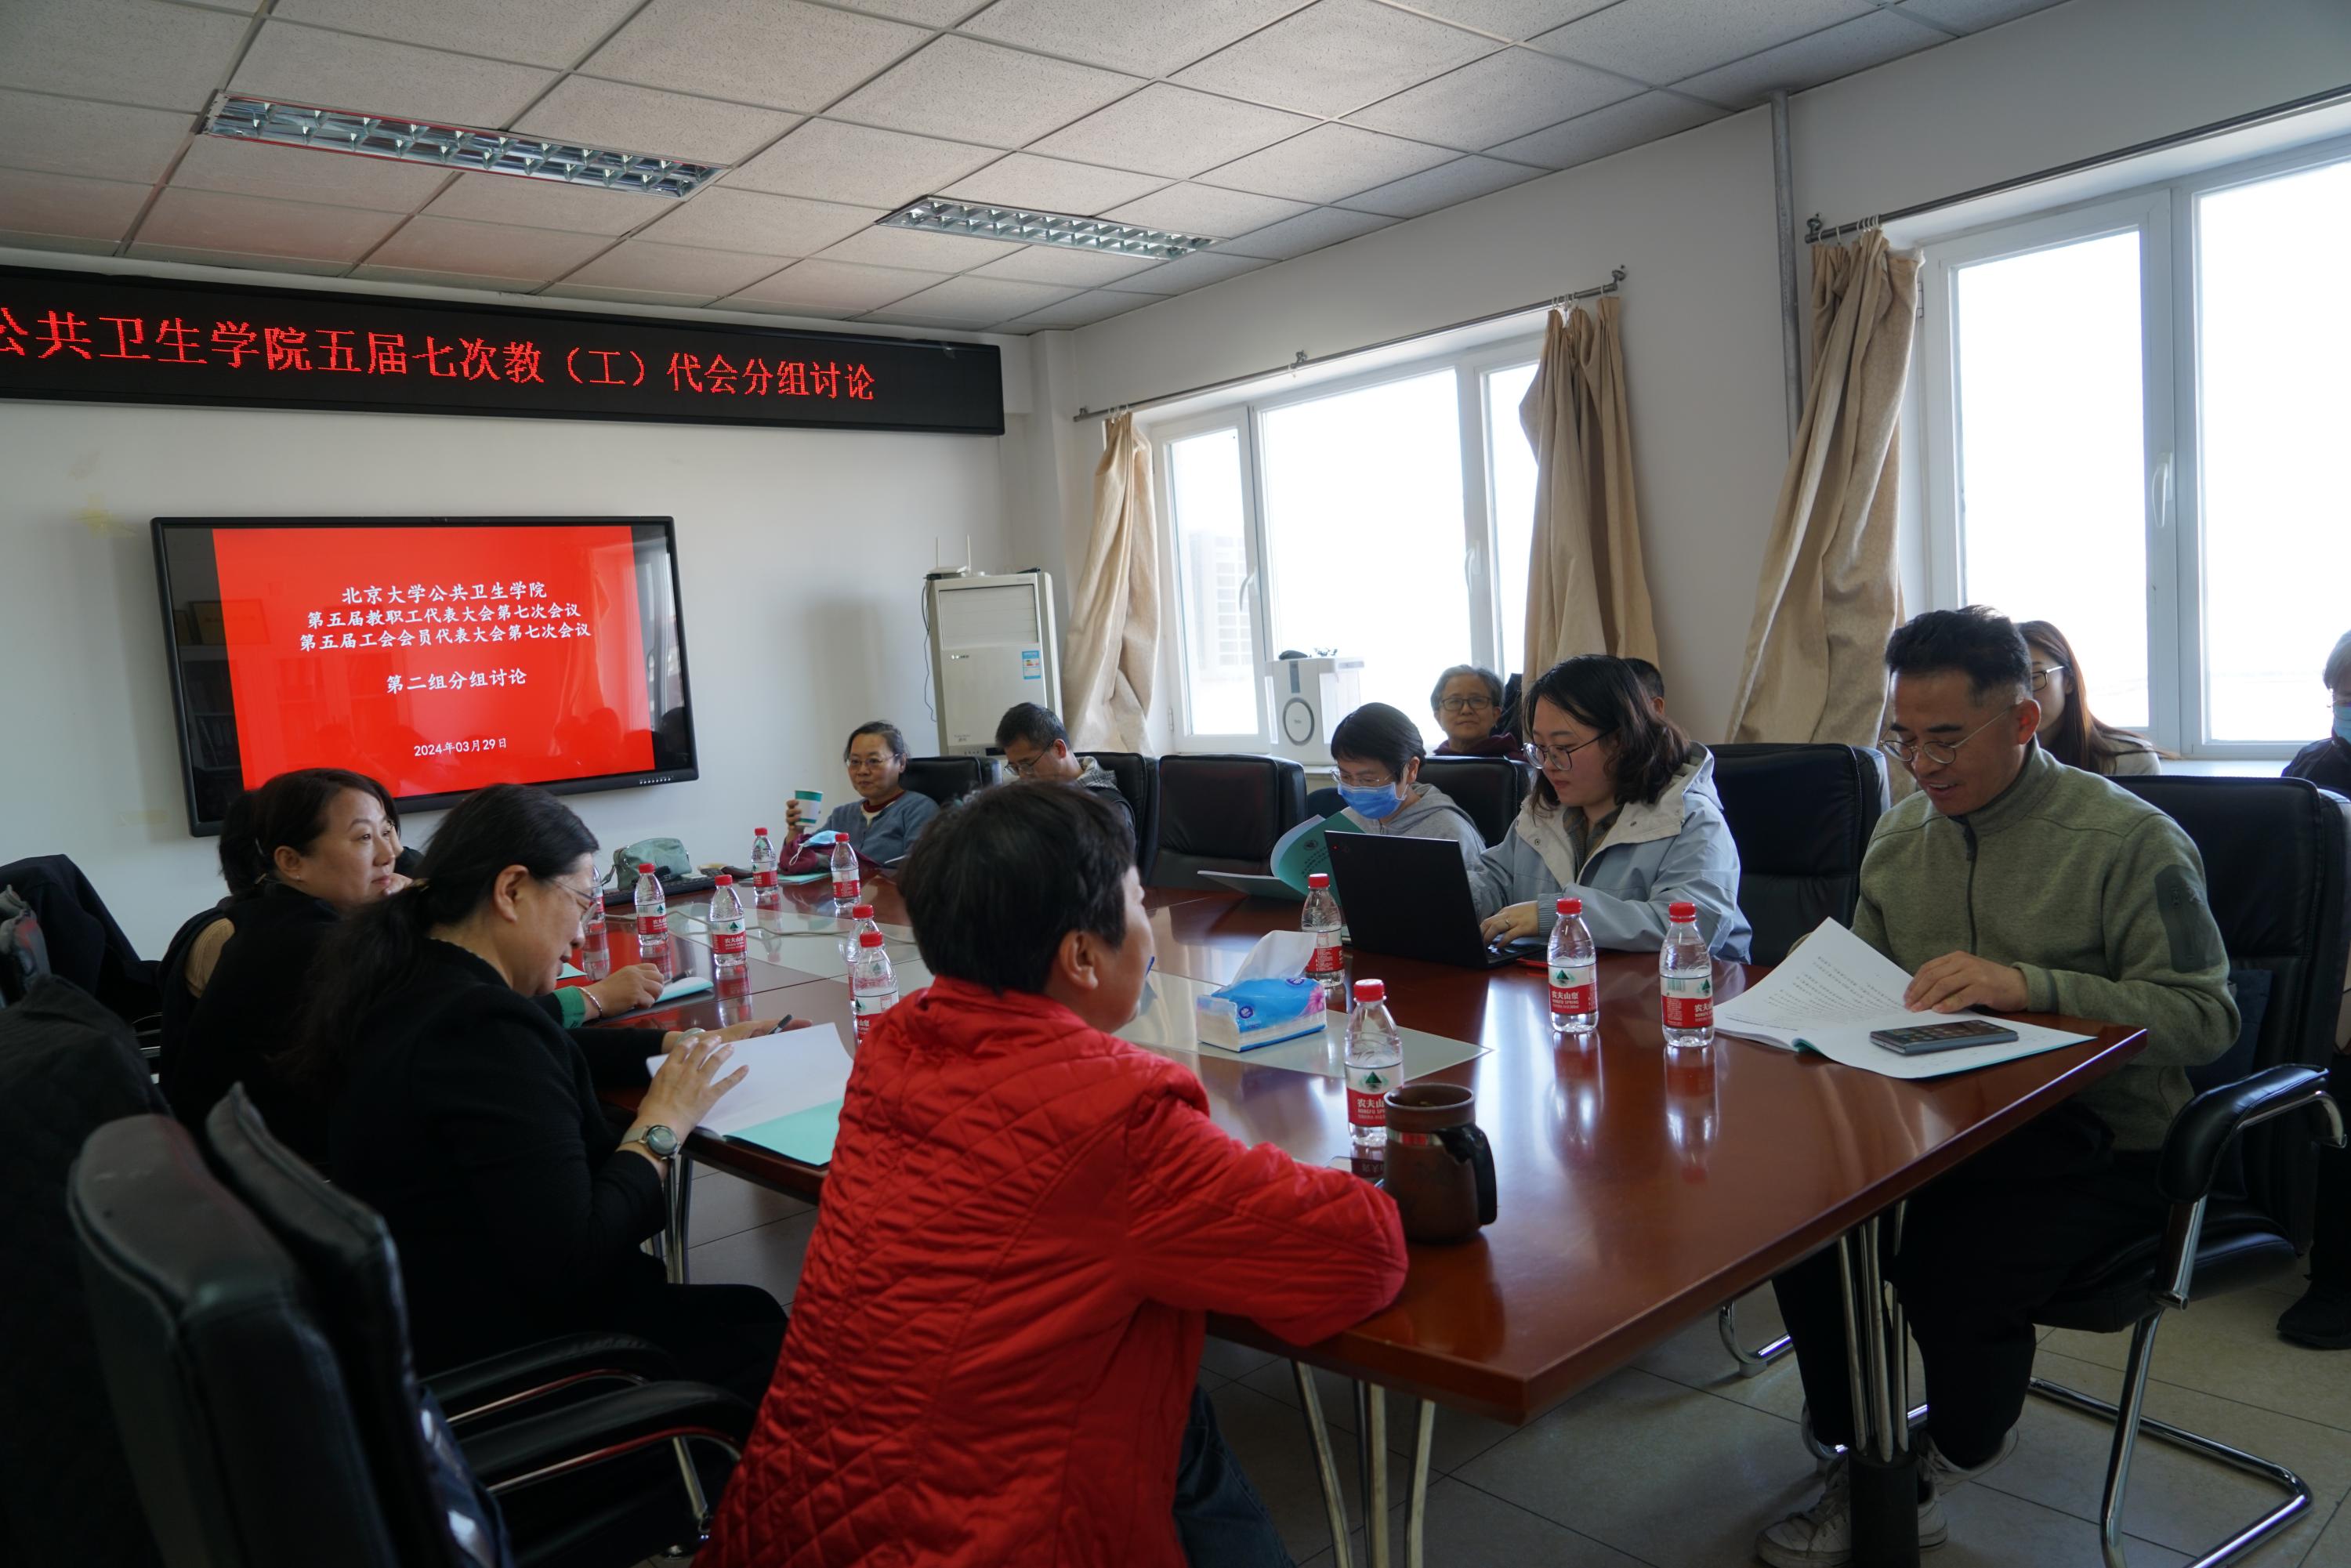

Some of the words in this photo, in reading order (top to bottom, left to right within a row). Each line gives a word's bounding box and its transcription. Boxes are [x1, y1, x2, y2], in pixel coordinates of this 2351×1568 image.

[342, 581, 547, 605] 北京大学公共卫生学院
[307, 602, 581, 630] 第五届教职工代表大会第七次会议
[299, 621, 592, 652] 第五届工会会员代表大会第七次会议
[386, 668, 527, 694] 第二组分组讨论
[414, 737, 507, 756] 2024年03月29日
[1552, 990, 1579, 1000] 农夫山泉
[1357, 1098, 1385, 1108] 农夫山
